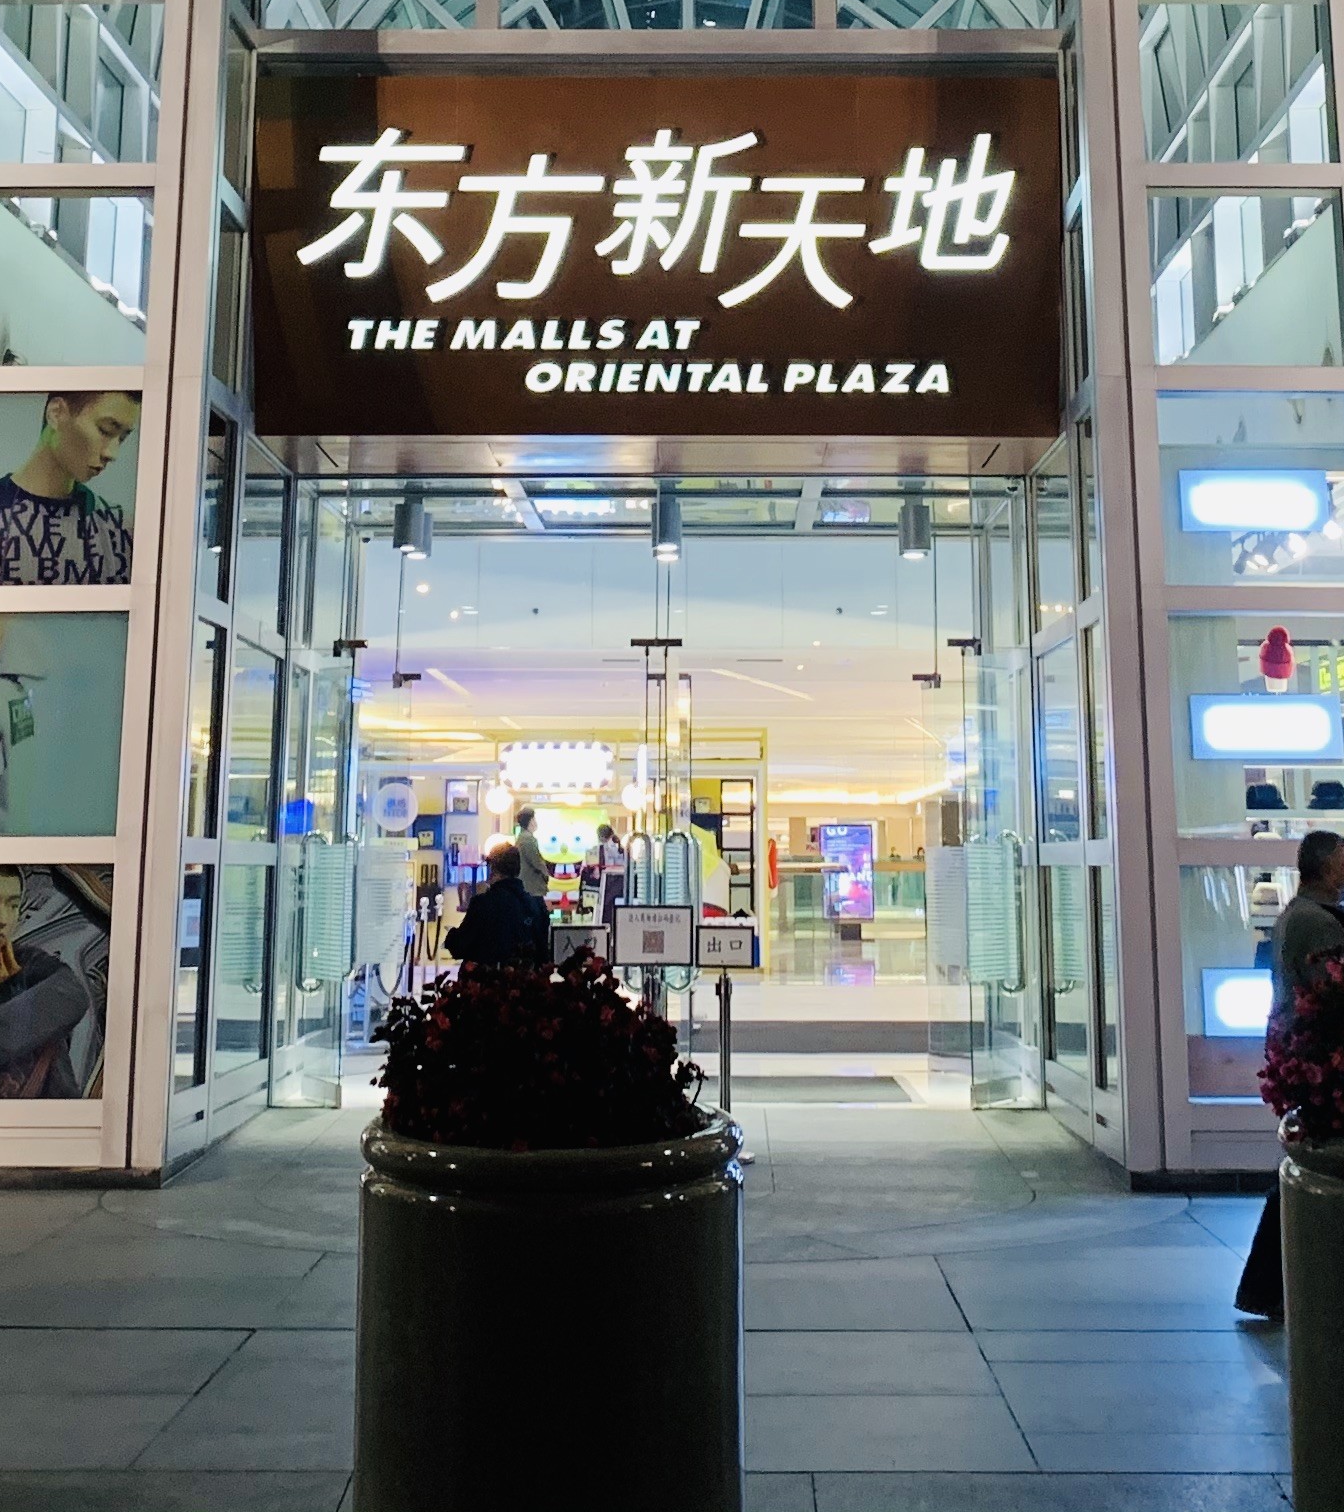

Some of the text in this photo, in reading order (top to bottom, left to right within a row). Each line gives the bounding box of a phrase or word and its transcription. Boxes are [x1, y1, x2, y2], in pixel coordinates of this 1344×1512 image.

[296, 126, 1017, 310] 东方新天地
[346, 319, 701, 351] THE MALLS AT
[524, 362, 952, 394] ORIENTAL PLAZA
[706, 936, 744, 953] 出口
